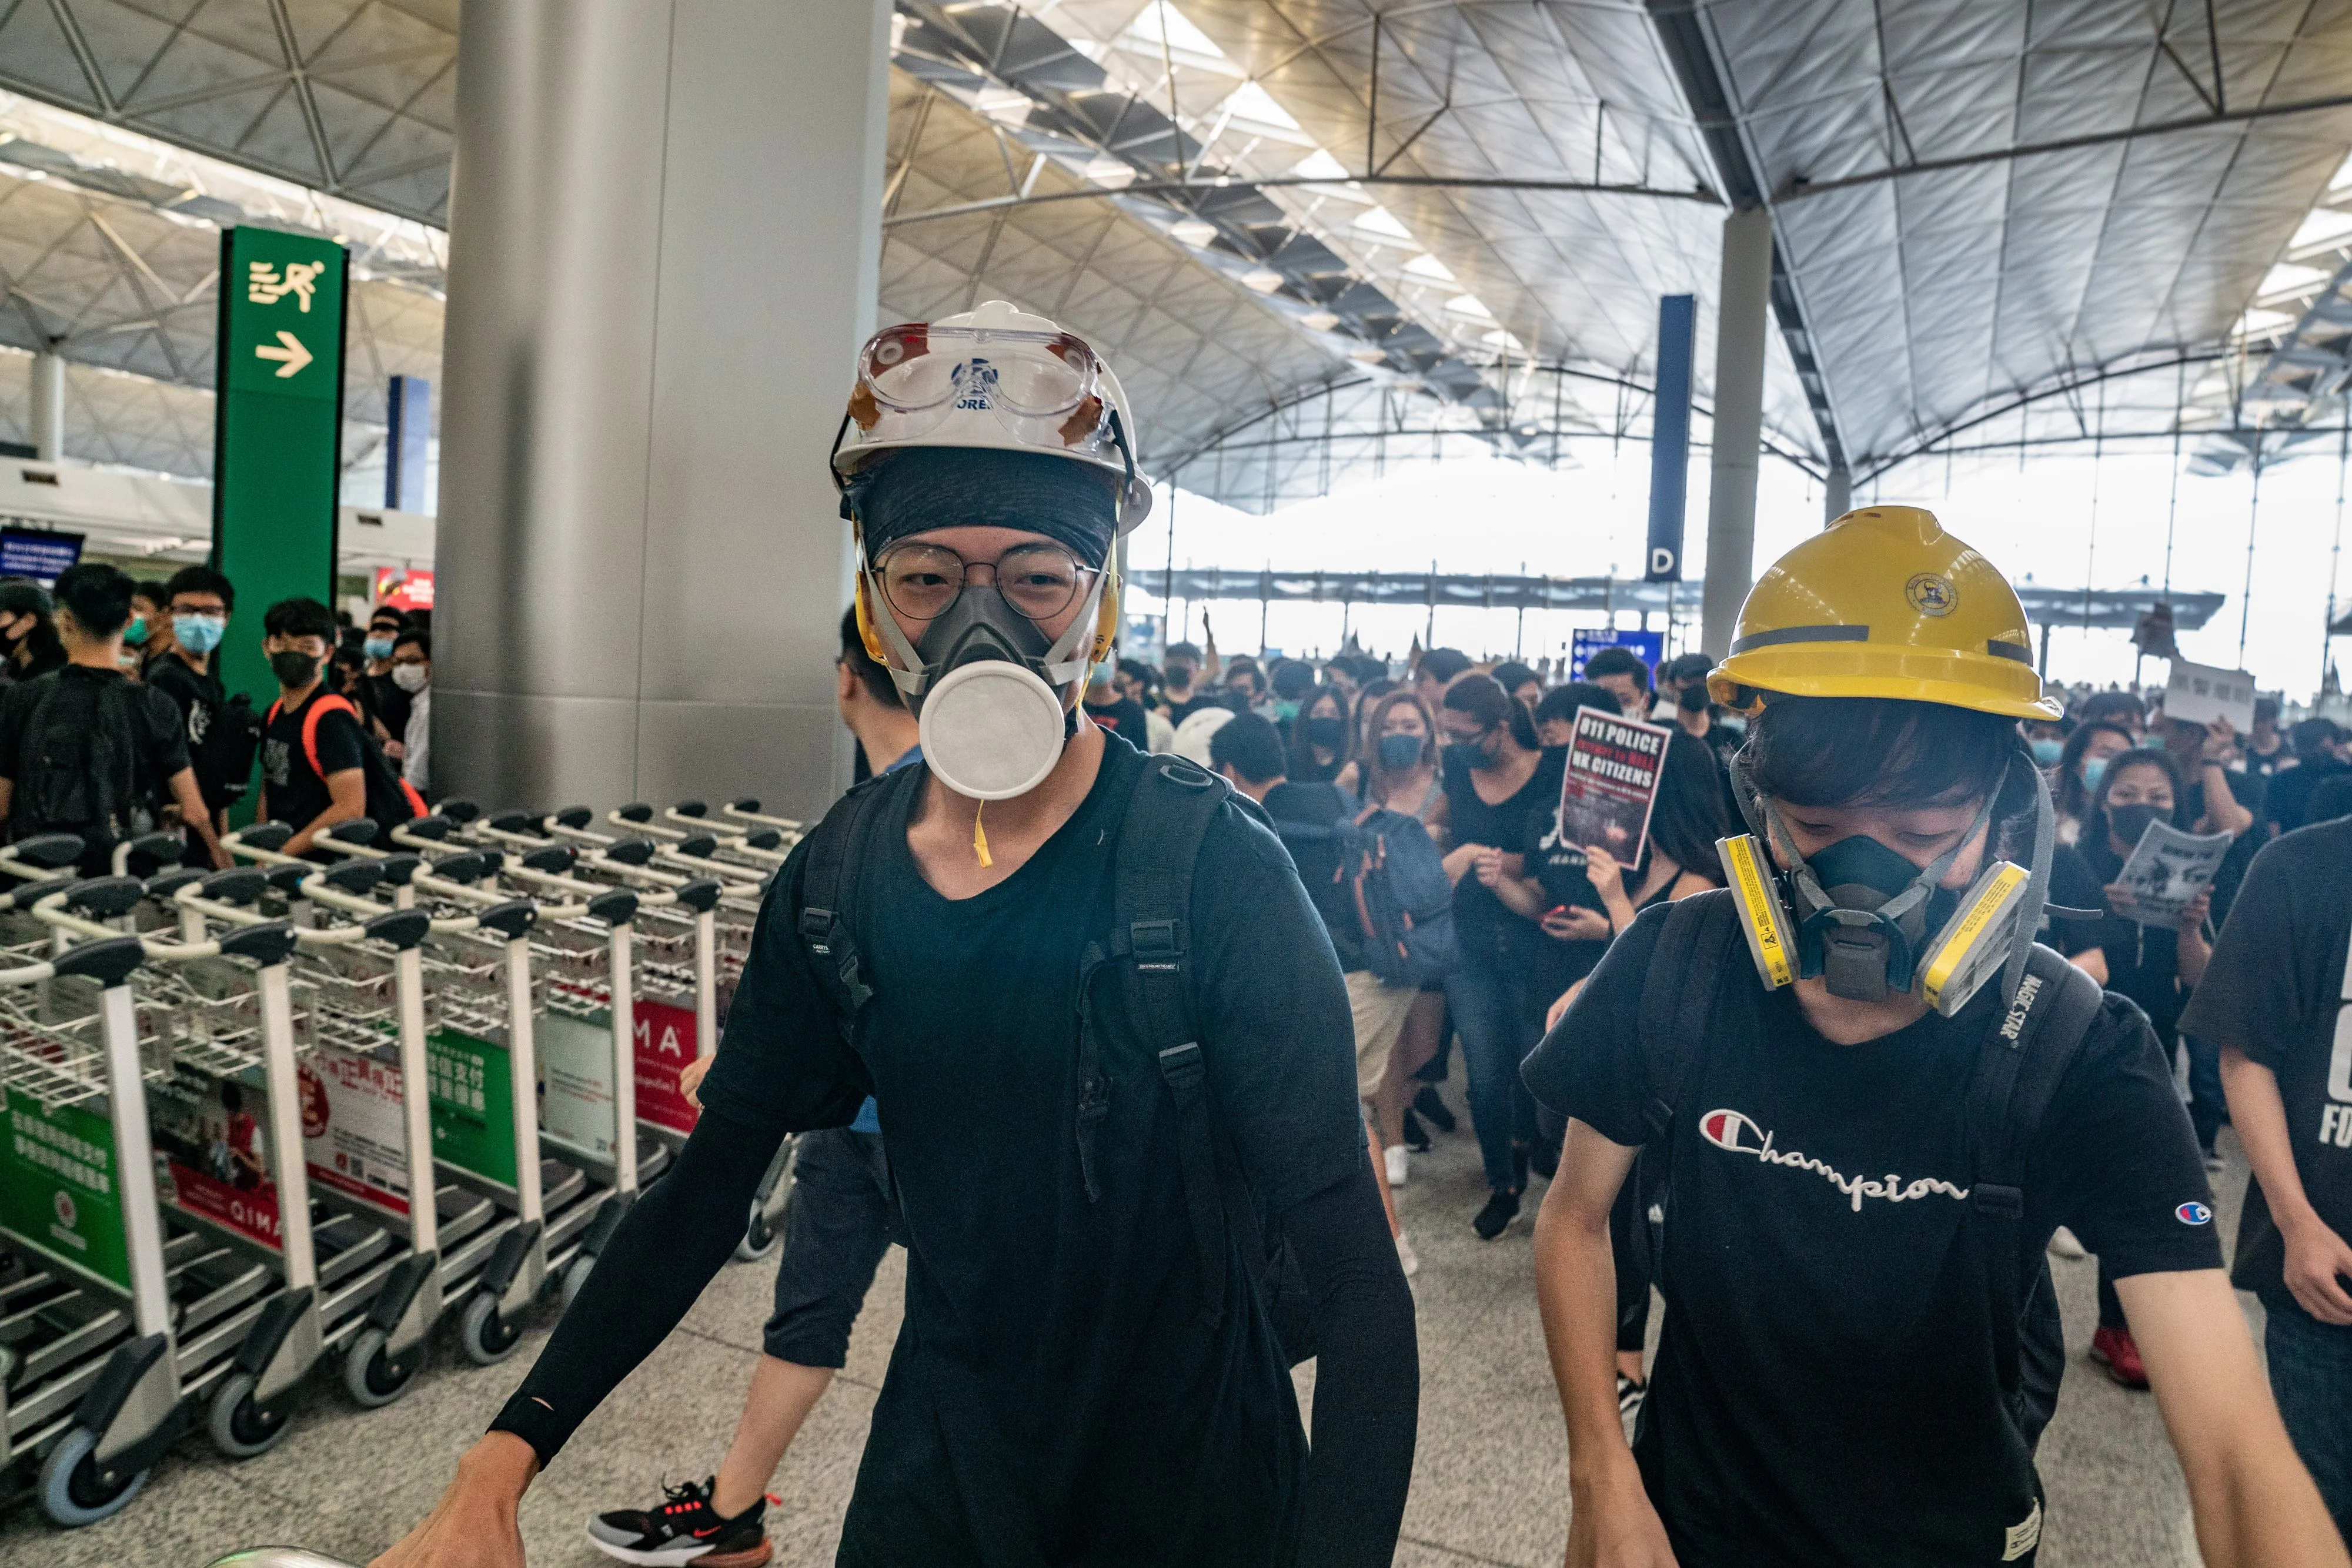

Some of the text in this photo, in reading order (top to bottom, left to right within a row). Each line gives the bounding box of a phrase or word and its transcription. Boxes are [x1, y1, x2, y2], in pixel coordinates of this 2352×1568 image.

[1652, 547, 1675, 574] D
[1606, 724, 1660, 755] POLICE
[1591, 755, 1653, 788] CITIZENS
[2000, 1009, 2026, 1040] STAR
[1699, 1109, 1970, 1212] Champion
